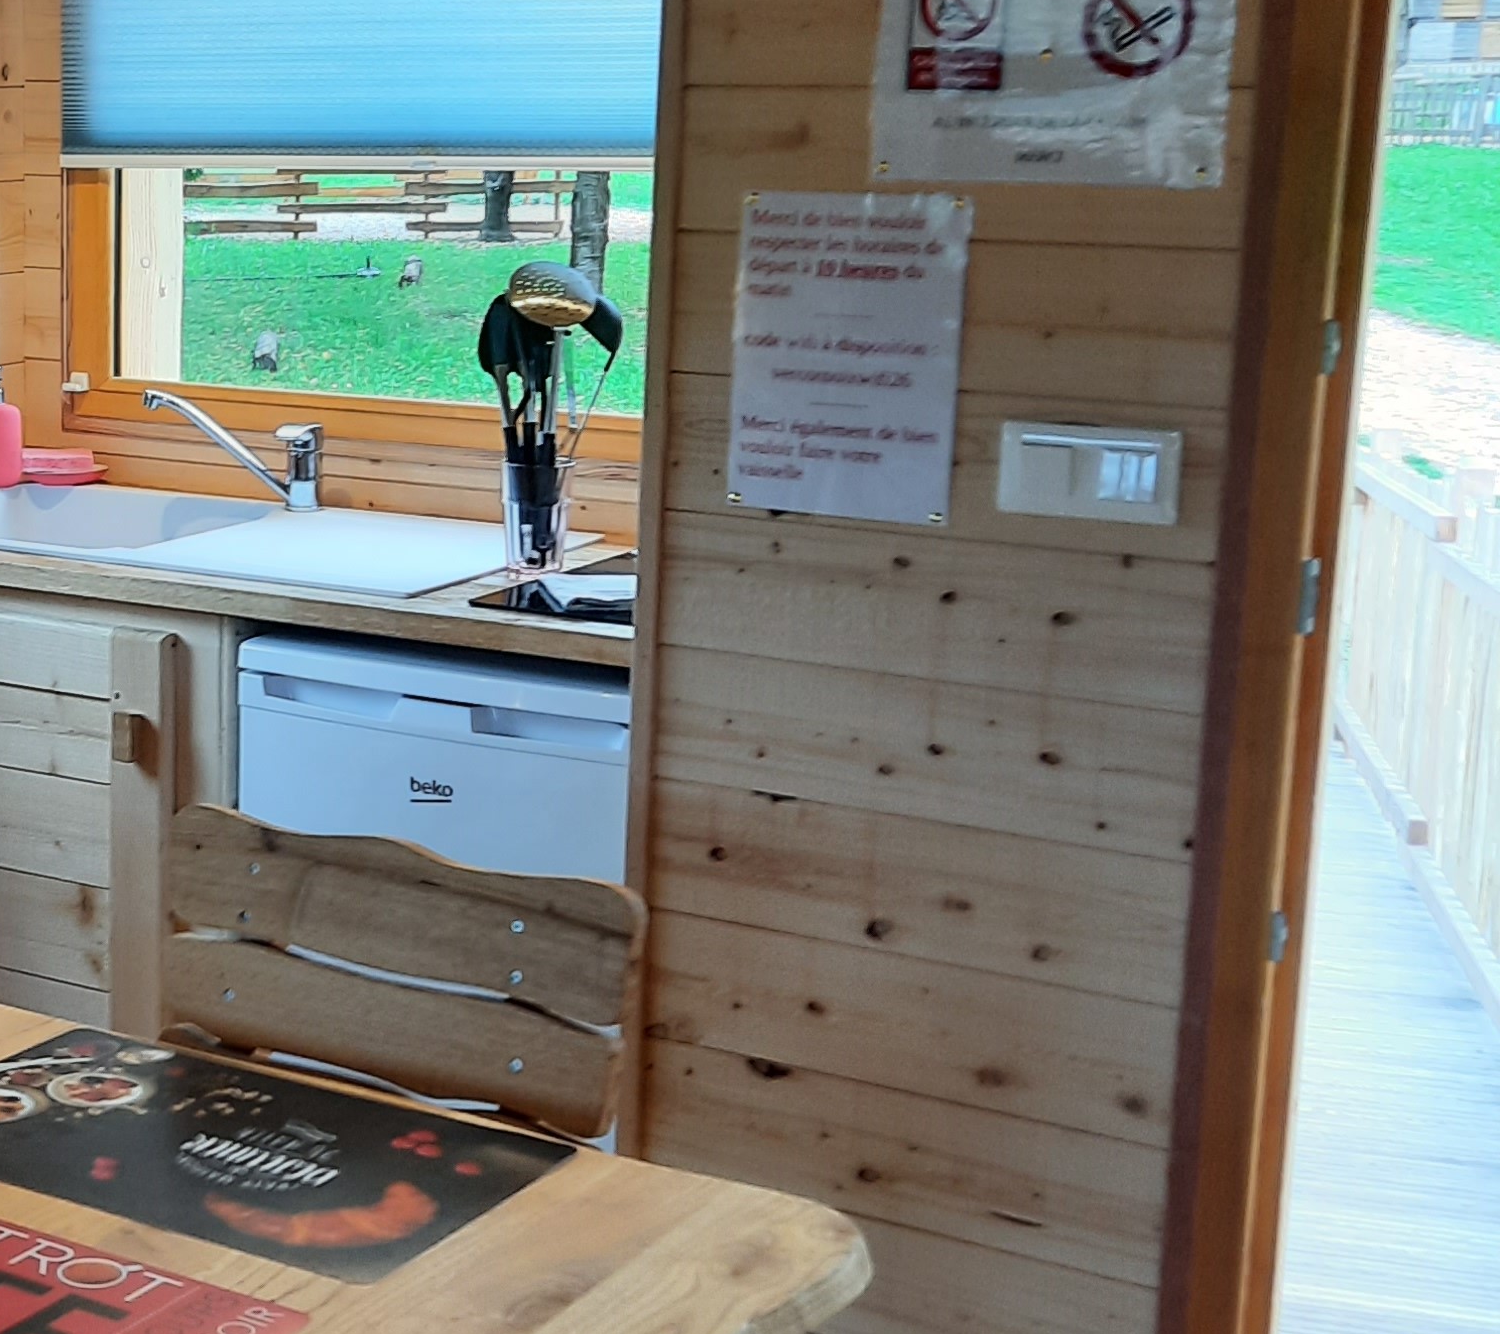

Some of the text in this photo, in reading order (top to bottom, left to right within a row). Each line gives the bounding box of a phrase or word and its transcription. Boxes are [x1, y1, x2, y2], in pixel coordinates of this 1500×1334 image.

[752, 209, 796, 225] Merci
[804, 212, 819, 226] de
[742, 416, 785, 432] Merci
[790, 419, 873, 439] également
[876, 424, 897, 440] de
[410, 777, 453, 798] beko
